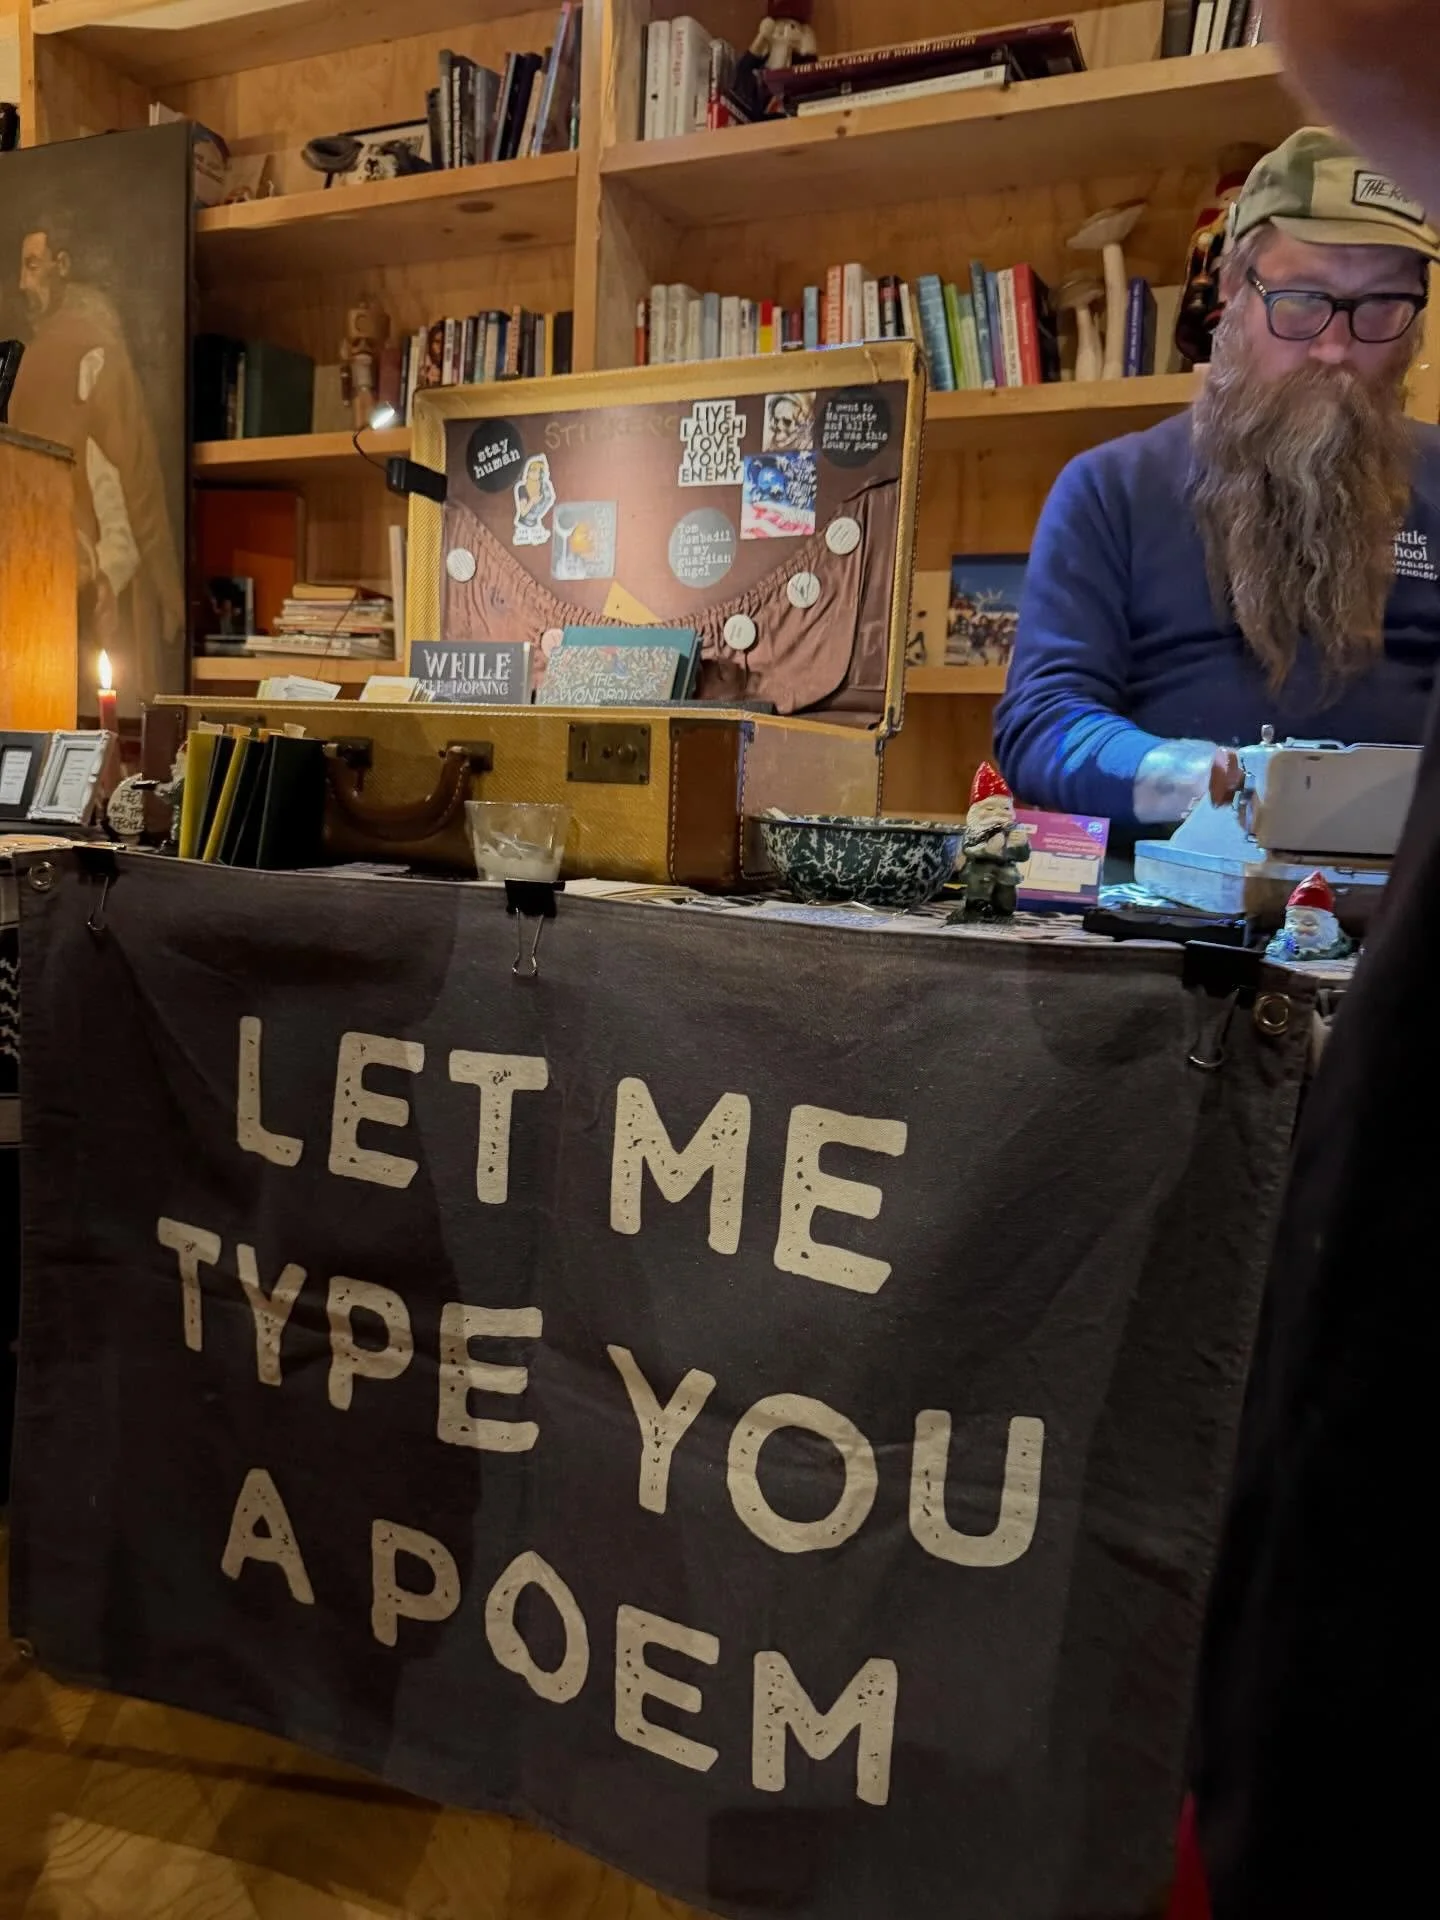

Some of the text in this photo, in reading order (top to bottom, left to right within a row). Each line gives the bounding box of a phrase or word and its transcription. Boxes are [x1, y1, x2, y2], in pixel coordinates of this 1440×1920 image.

[696, 405, 732, 421] LIVE
[684, 420, 743, 437] LAUGH
[477, 438, 509, 462] stay
[690, 435, 734, 452] LOVE
[473, 448, 521, 479] human
[687, 449, 736, 466] YOUR
[682, 465, 741, 483] ENEMY
[423, 649, 512, 680] WHILE
[237, 1015, 908, 1295] LET ME
[157, 1217, 1046, 1567] TYPE YOU
[221, 1468, 898, 1805] A POEM
